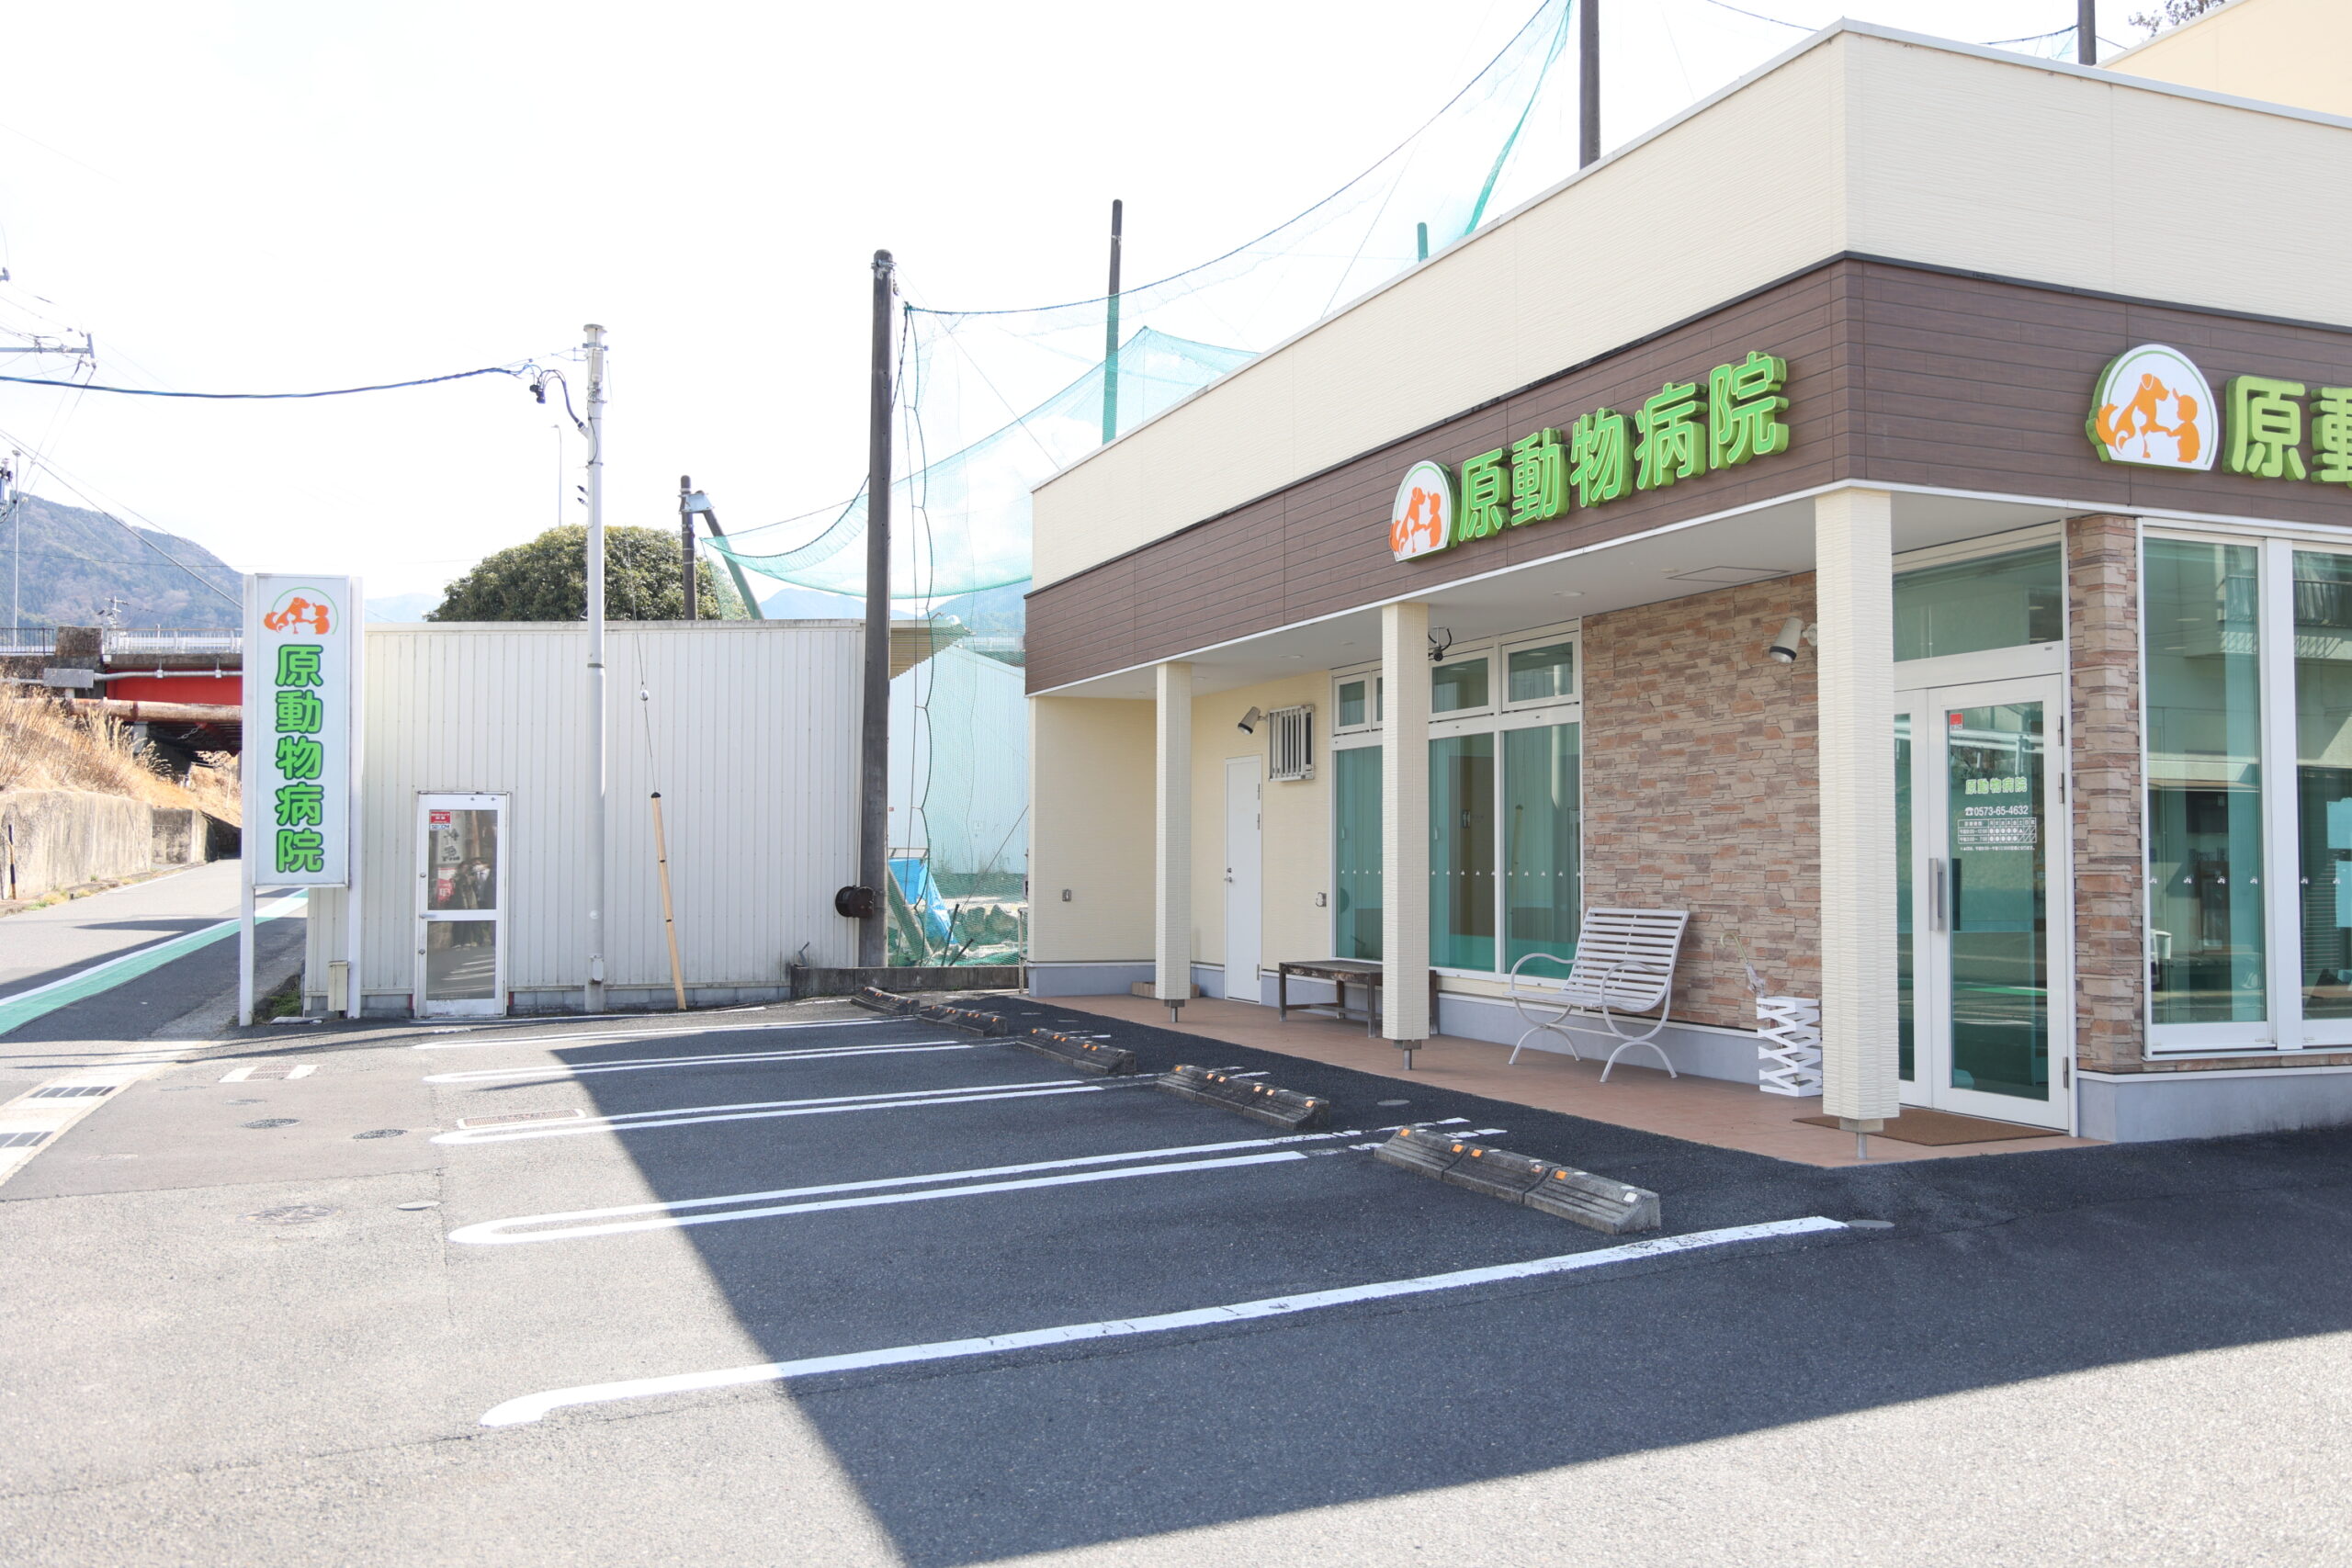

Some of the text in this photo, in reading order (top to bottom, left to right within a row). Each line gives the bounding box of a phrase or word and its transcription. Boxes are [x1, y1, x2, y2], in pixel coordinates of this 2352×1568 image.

[1458, 351, 1790, 542] 原動物病院
[274, 643, 324, 874] 原動物病院
[1965, 777, 2027, 794] 原動物病院
